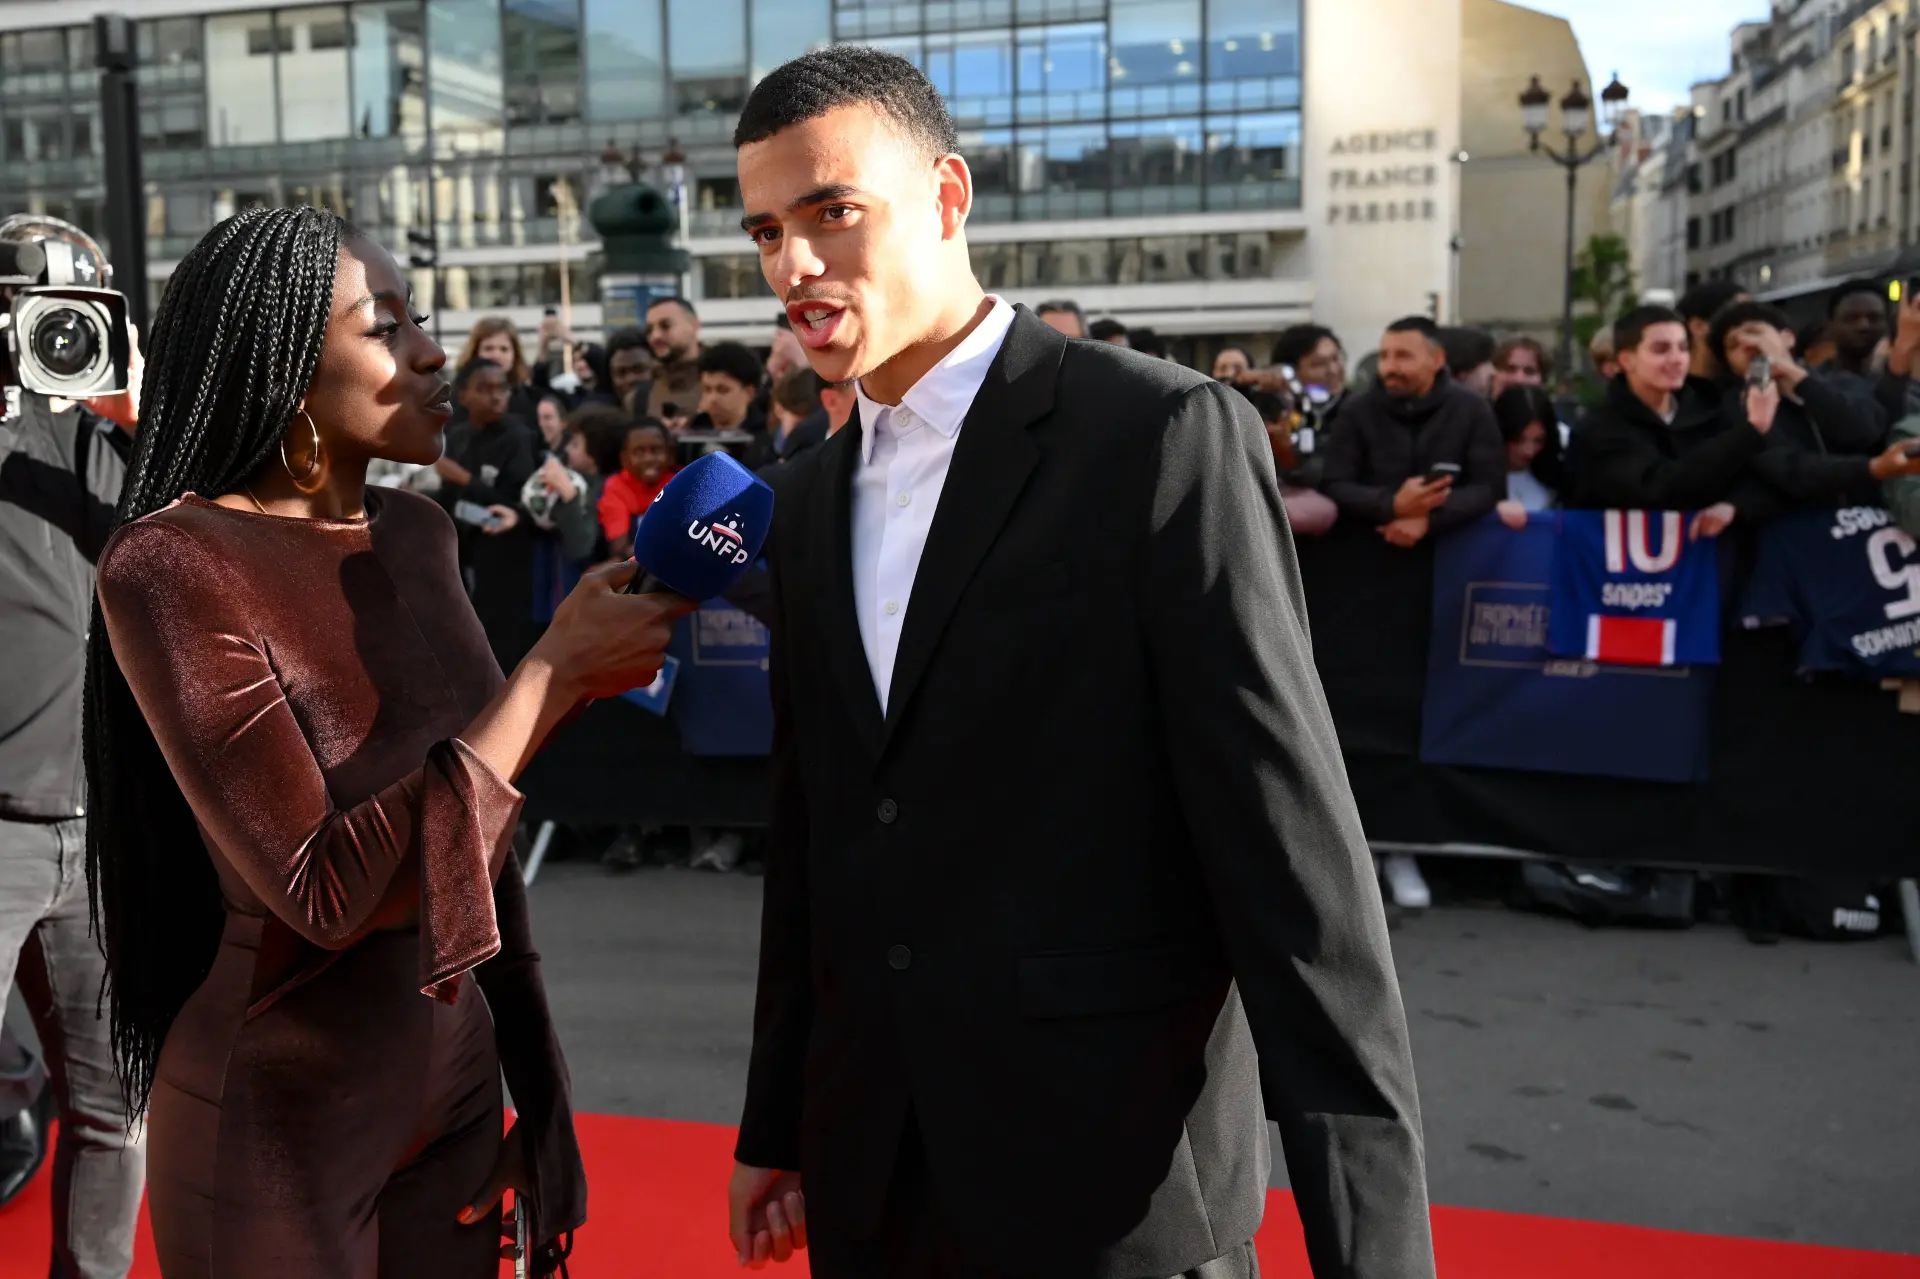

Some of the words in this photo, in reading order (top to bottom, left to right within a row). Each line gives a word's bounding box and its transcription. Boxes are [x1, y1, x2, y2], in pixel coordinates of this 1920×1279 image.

[1330, 130, 1435, 153] AGENCE
[1330, 166, 1435, 190] FRANCE
[1328, 198, 1434, 223] PRESSE
[688, 520, 748, 564] UNFP
[1867, 526, 1920, 619] 5
